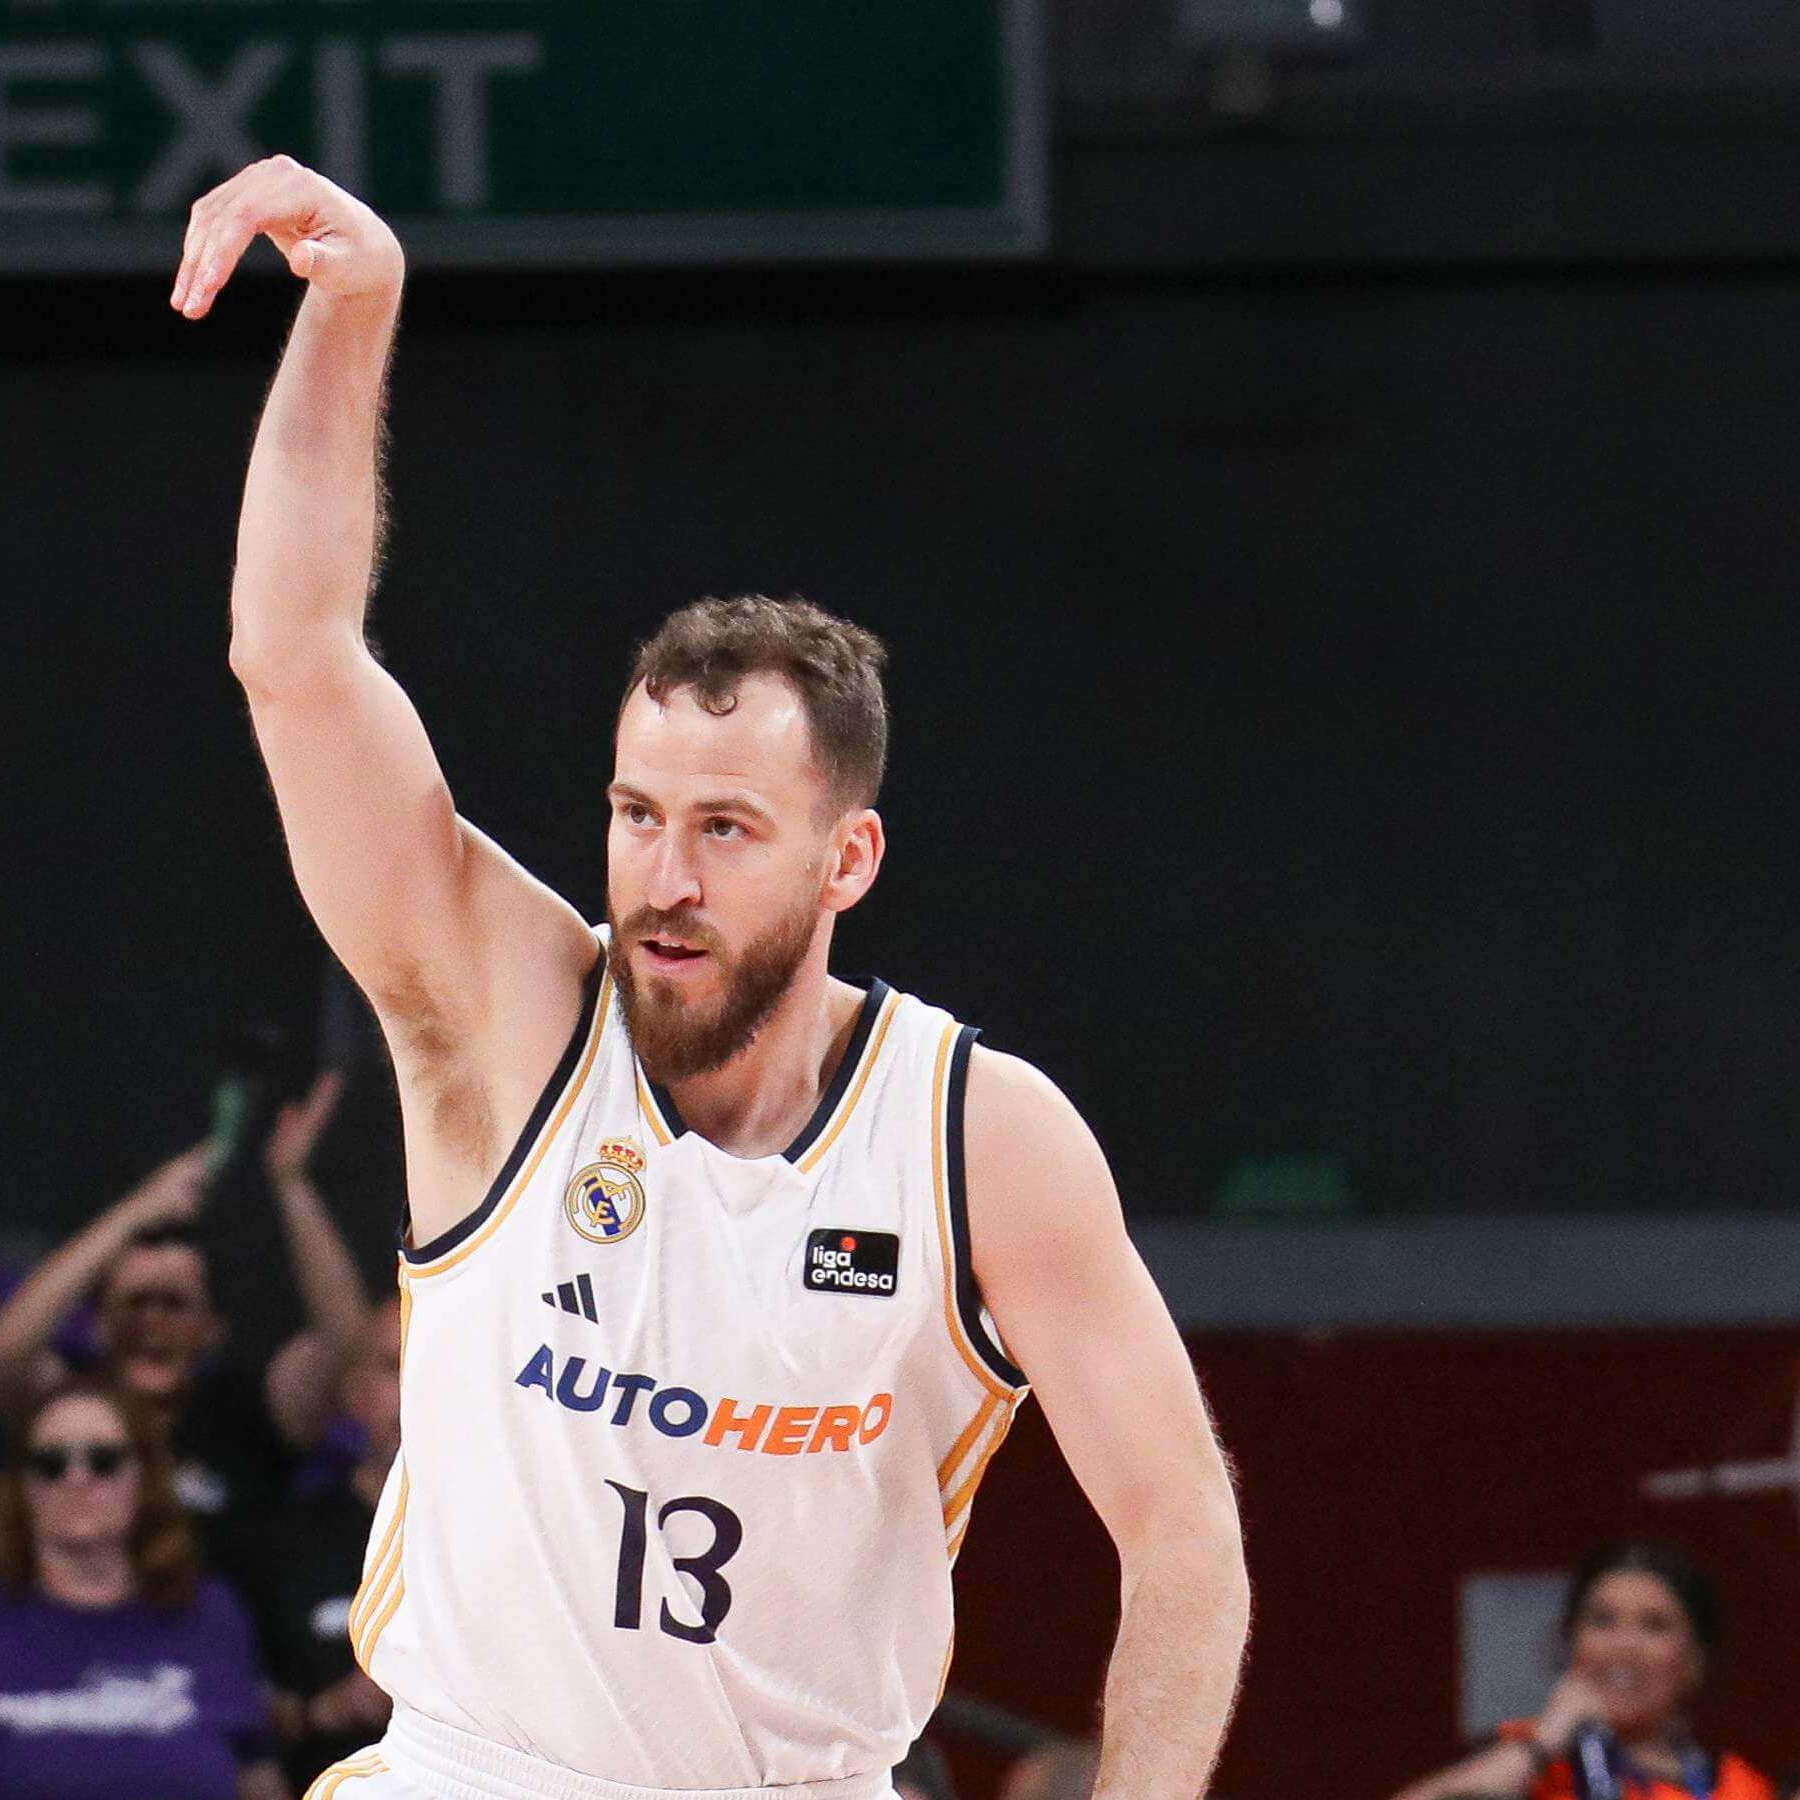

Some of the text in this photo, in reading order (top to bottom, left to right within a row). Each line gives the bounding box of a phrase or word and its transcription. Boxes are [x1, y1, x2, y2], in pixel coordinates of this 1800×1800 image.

[811, 1267, 893, 1290] endesa
[812, 1245, 851, 1268] liga
[515, 1343, 893, 1455] AUTOHERO
[604, 1479, 743, 1644] 13
